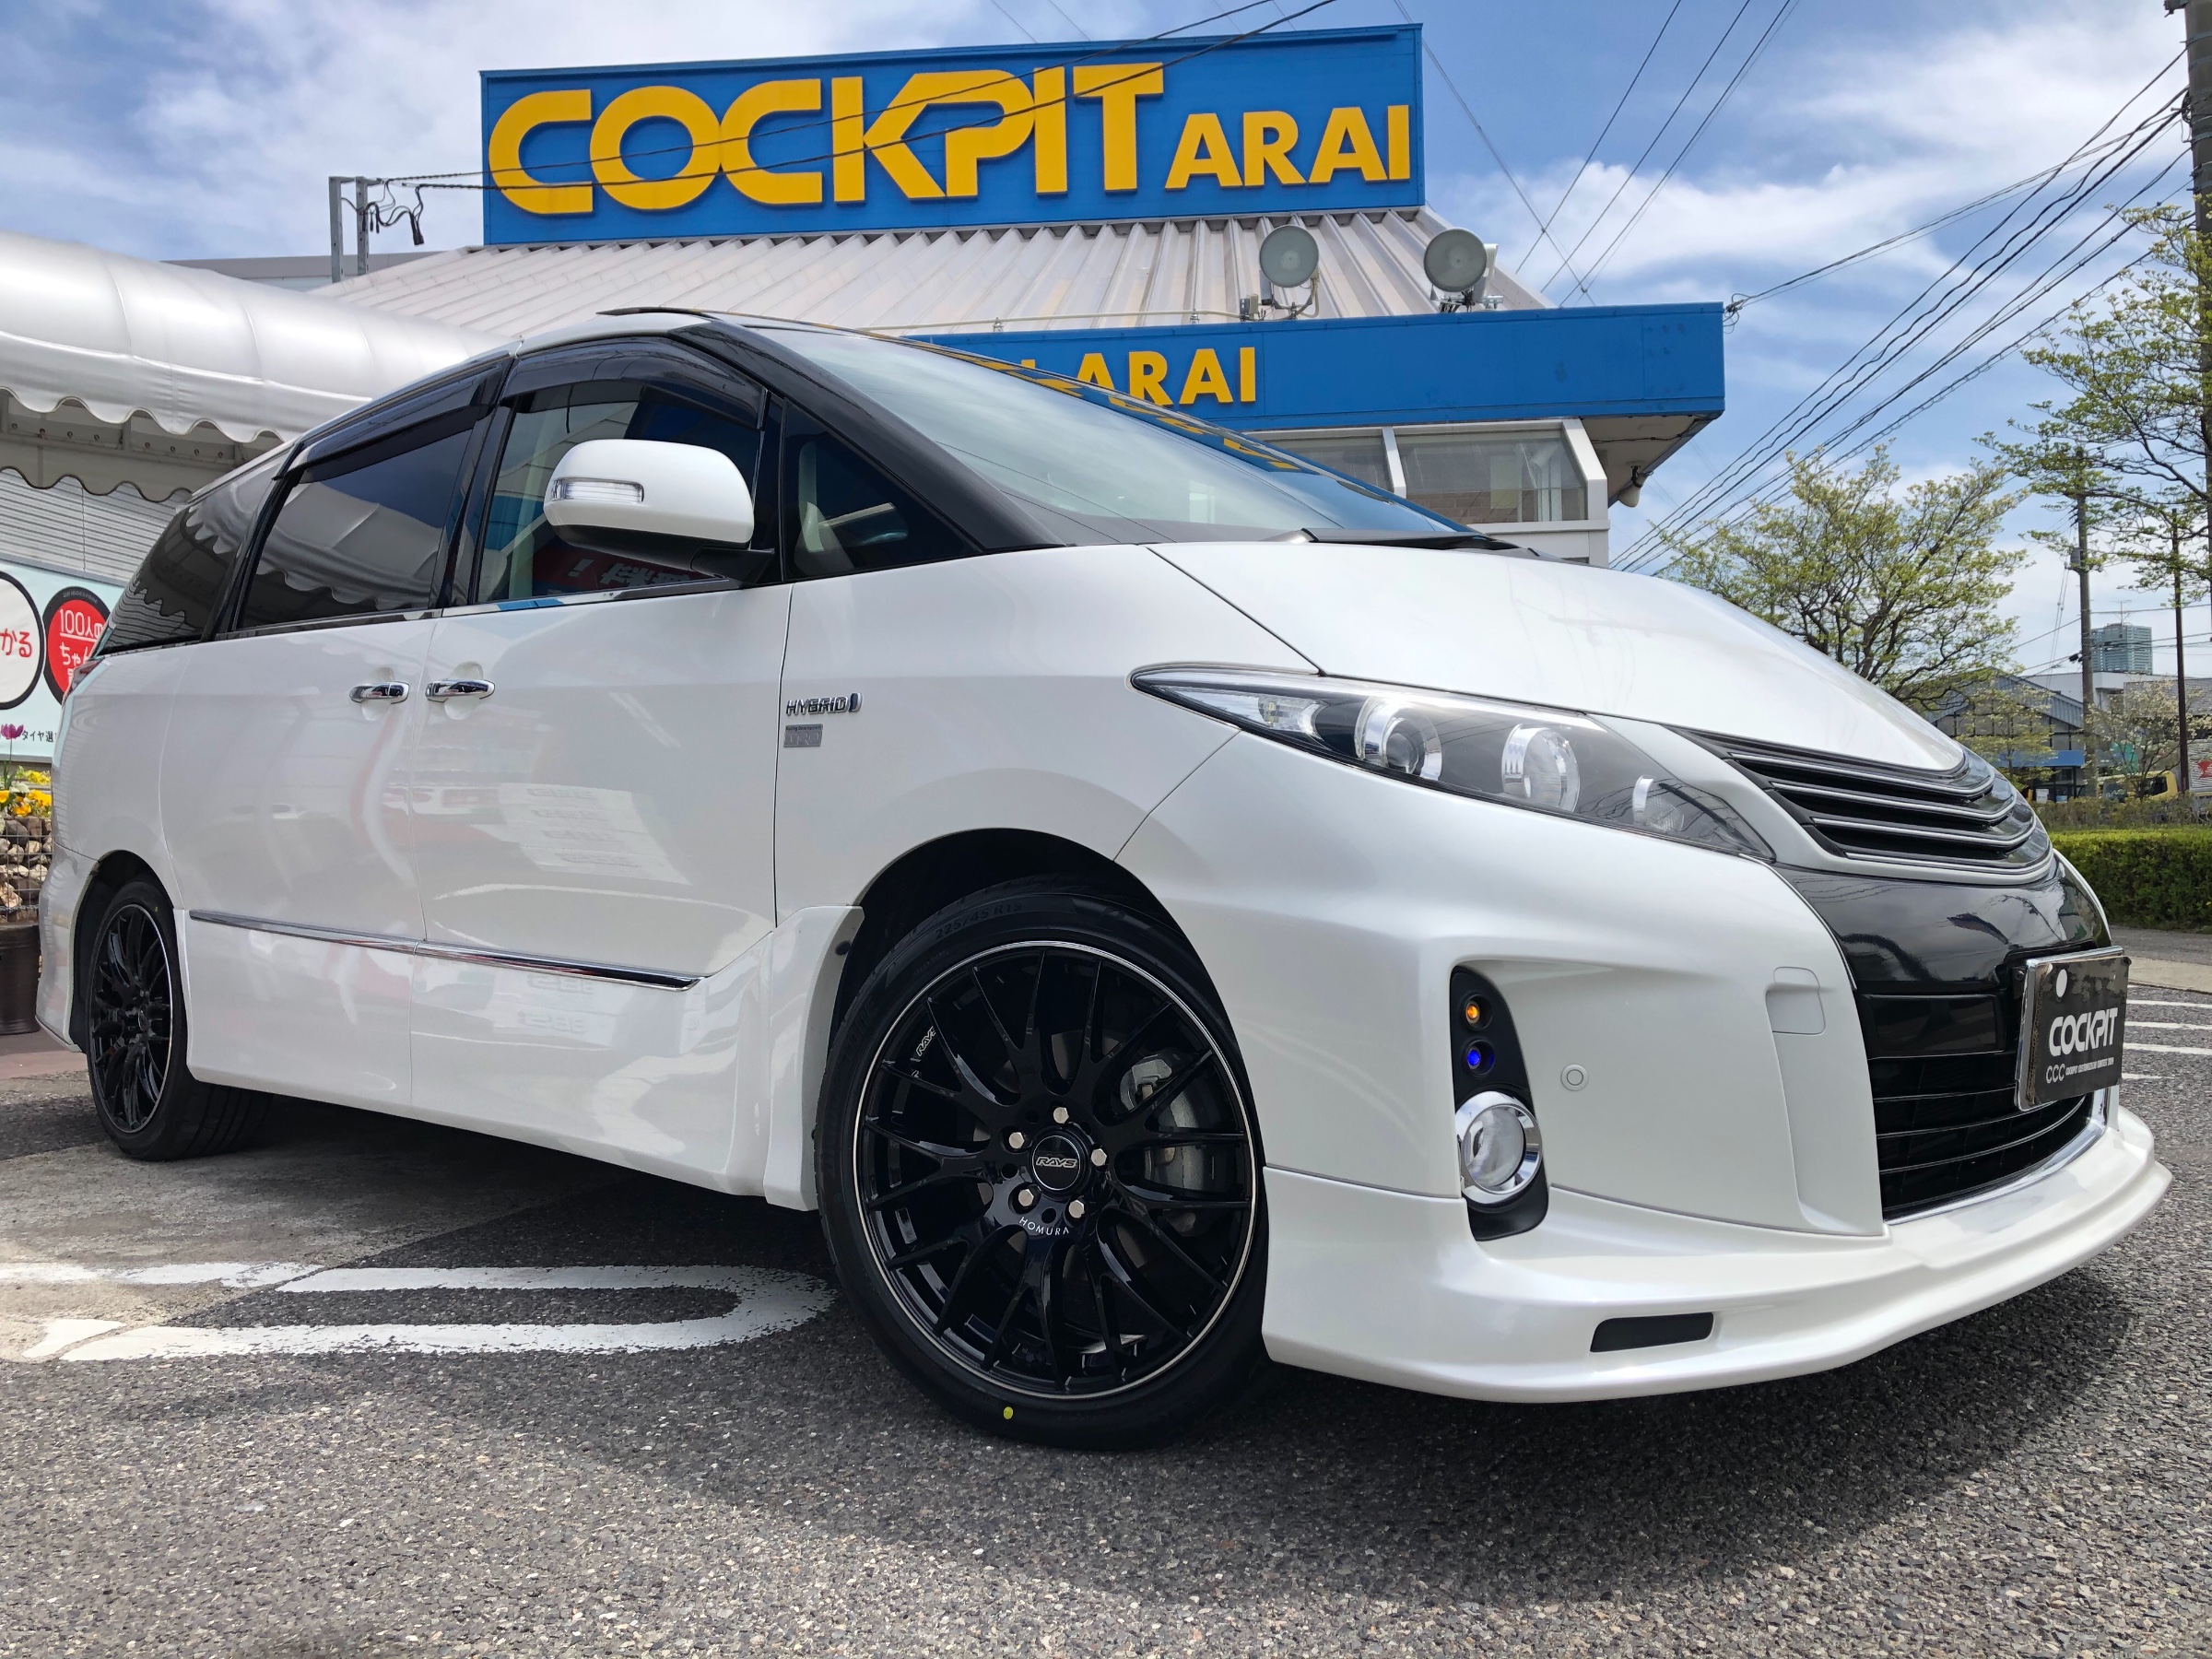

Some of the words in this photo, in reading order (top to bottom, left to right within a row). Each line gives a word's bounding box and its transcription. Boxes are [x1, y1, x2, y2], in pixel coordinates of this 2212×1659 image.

[488, 63, 1164, 214] COCKPIT
[1165, 104, 1411, 190] ARAI
[1076, 347, 1257, 406] ARAI
[786, 697, 848, 716] HYBRID
[22, 730, 57, 743] タイヤ選
[2049, 1007, 2119, 1057] COCKPIT
[2045, 1064, 2065, 1084] CCC
[1036, 1156, 1077, 1169] RAYS
[1018, 1216, 1069, 1236] HOMURA
